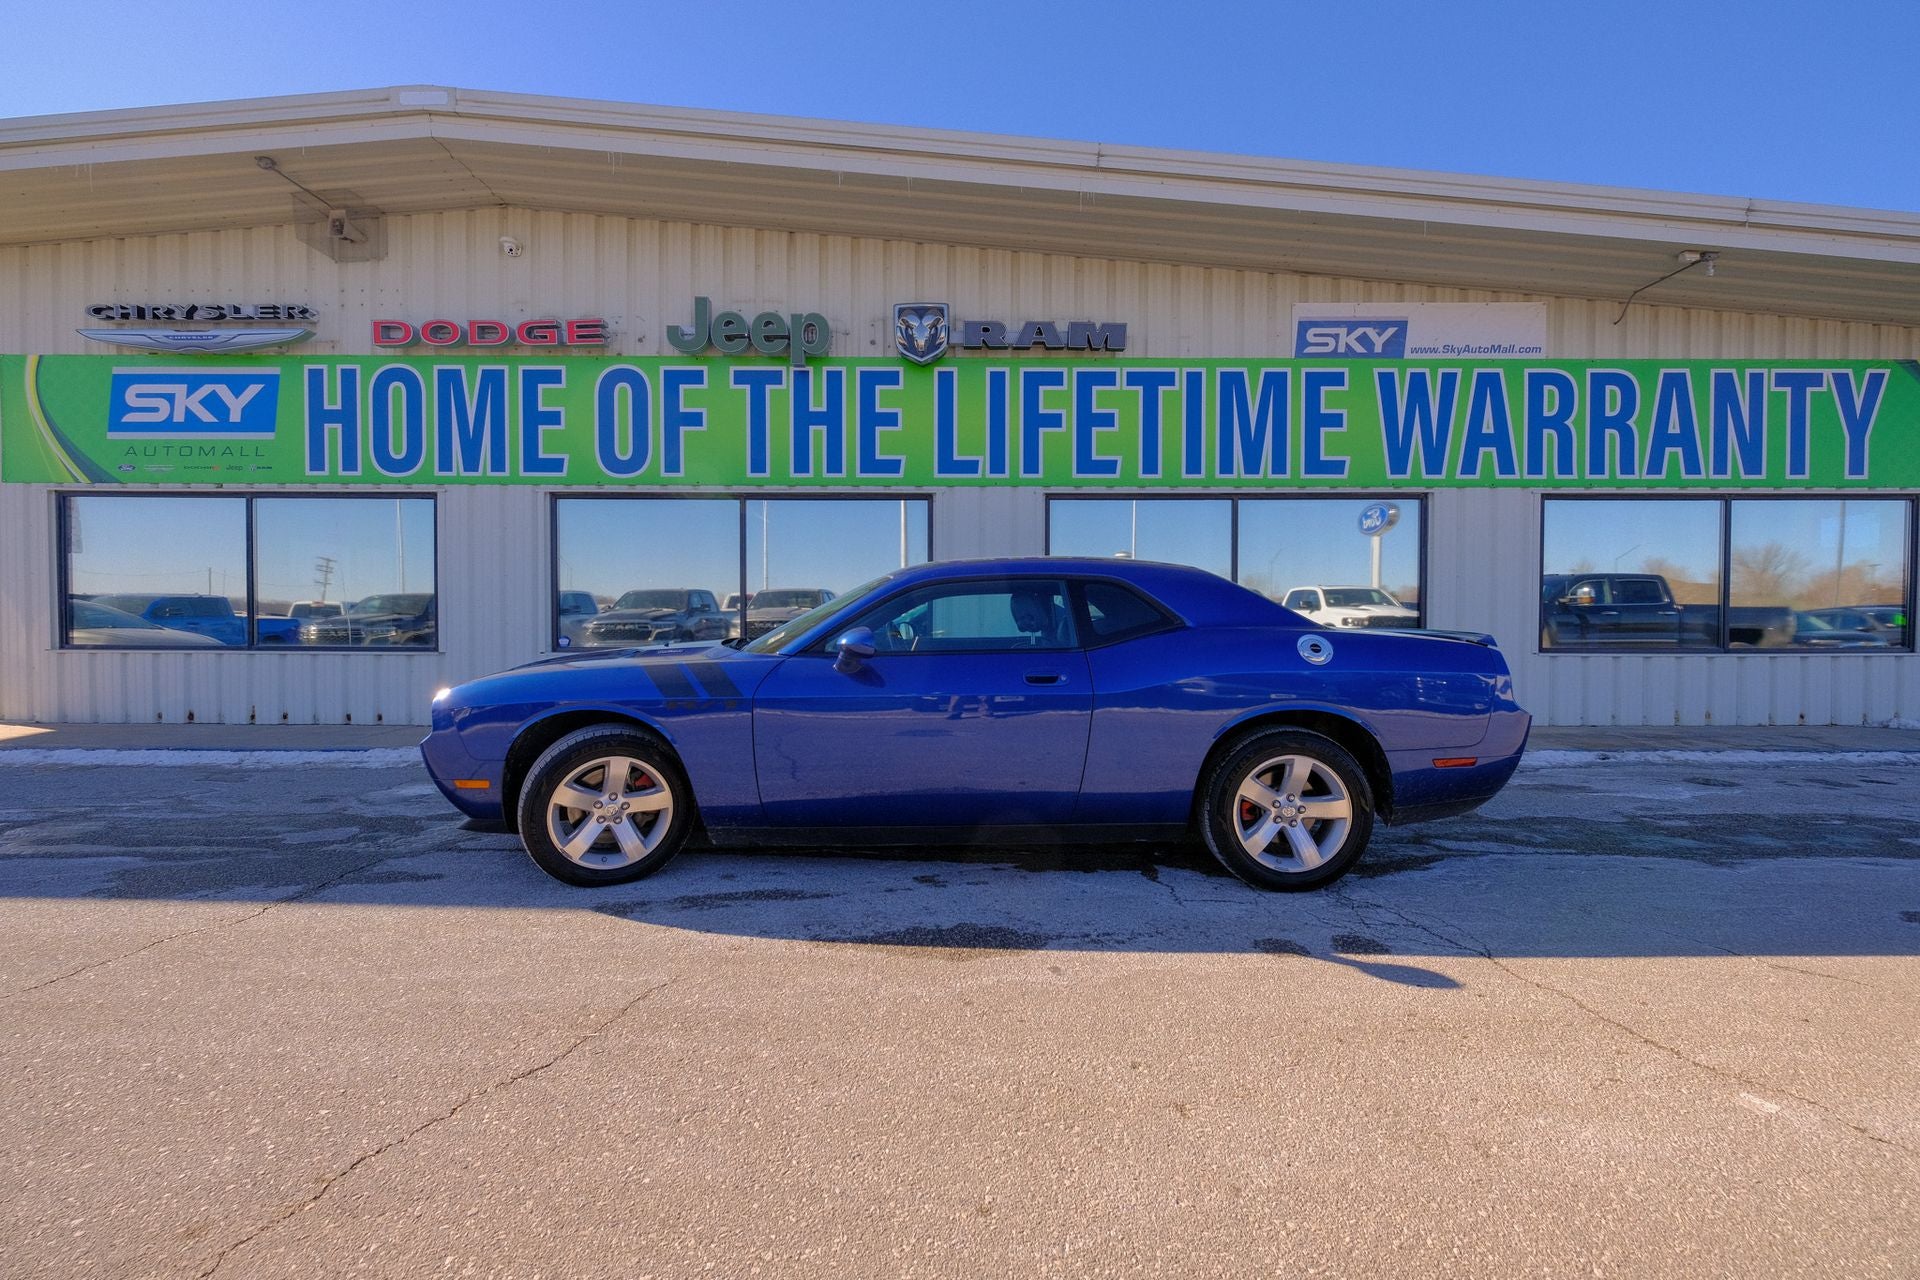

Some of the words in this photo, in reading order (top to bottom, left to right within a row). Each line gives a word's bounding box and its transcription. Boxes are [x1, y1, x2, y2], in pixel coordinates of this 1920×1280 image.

[85, 303, 320, 321] CHRYSLER
[372, 319, 610, 347] DODGE
[667, 296, 831, 367] Jeep
[963, 320, 1127, 351] RAM
[1303, 327, 1399, 353] SKY
[1410, 344, 1542, 356] www.SkyAutoMall.com
[120, 383, 265, 423] SKY
[304, 364, 569, 477] HOME
[594, 364, 708, 477] OF
[729, 365, 906, 478] THE
[933, 366, 1351, 479] LIFETIME
[1374, 367, 1891, 481] WARRANTY
[124, 446, 265, 457] AUTOMALL
